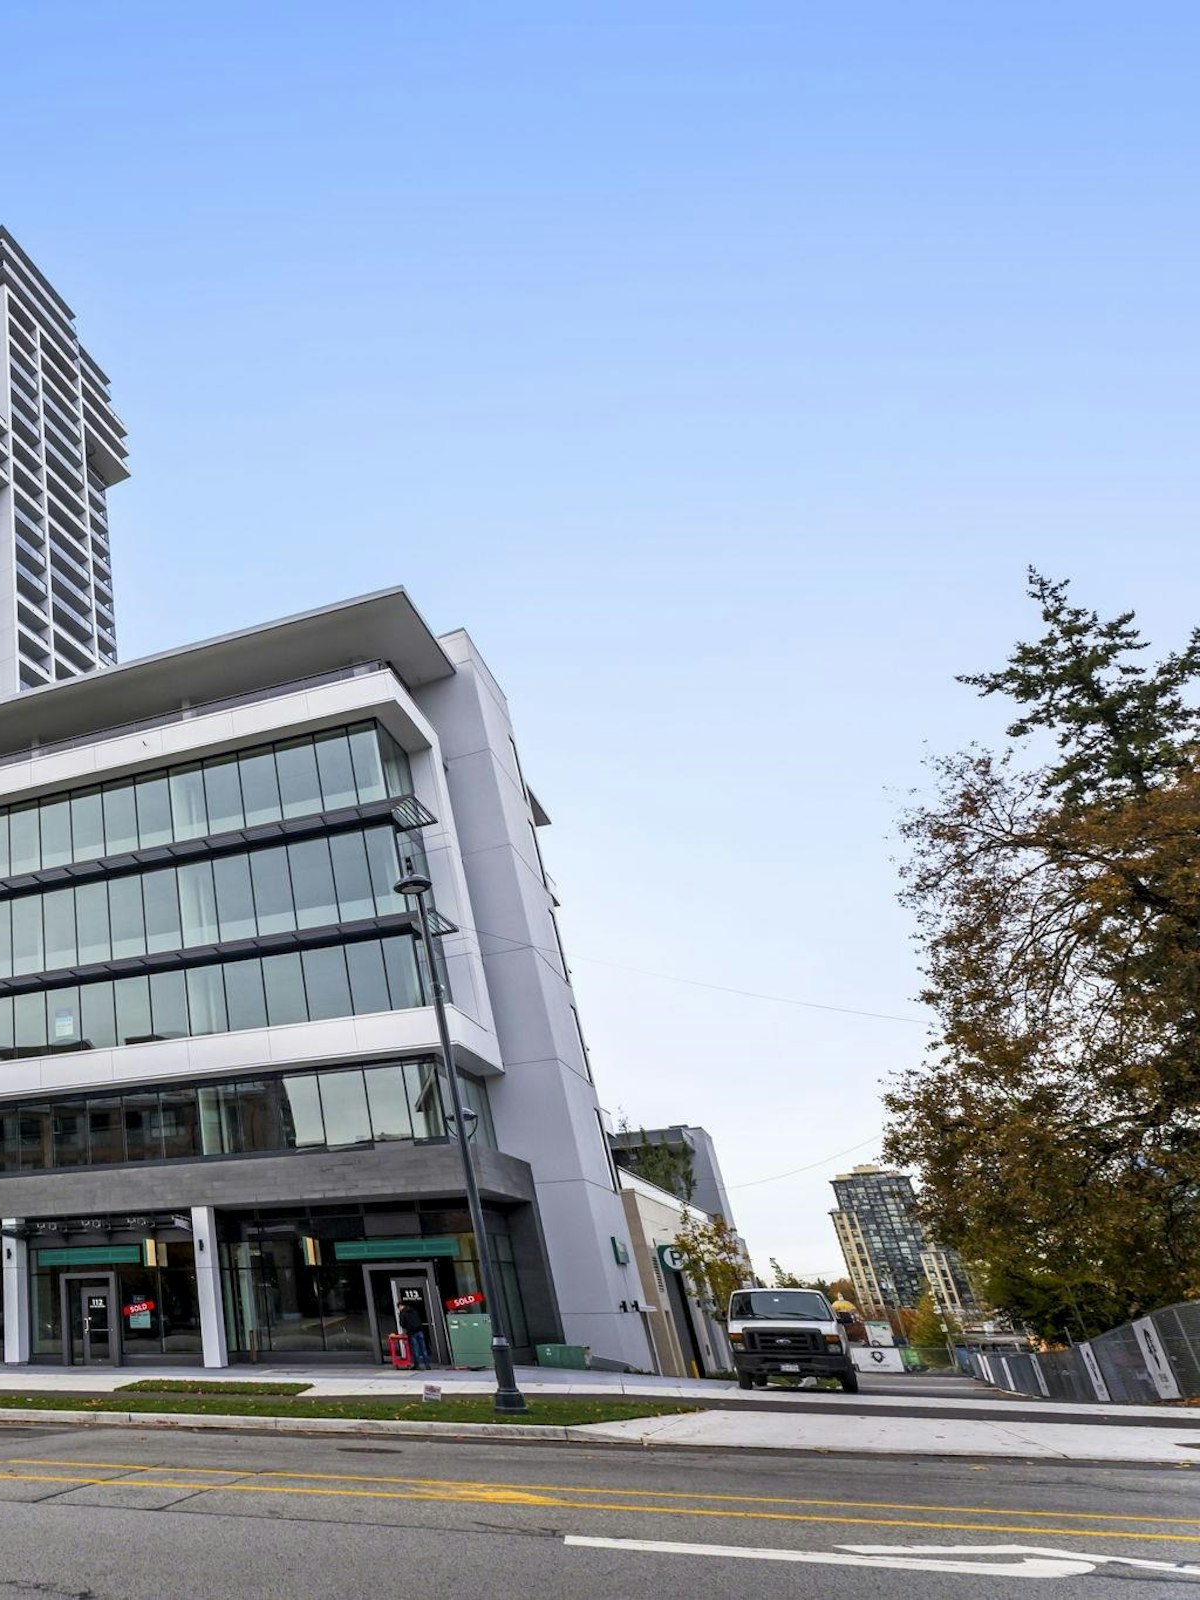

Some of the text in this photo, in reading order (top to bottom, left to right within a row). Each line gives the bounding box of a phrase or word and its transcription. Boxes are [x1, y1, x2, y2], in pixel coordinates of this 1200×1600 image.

[405, 1290, 419, 1298] 113
[92, 1298, 103, 1306] 112
[454, 1295, 475, 1307] SOLD
[129, 1303, 147, 1313] SOLD
